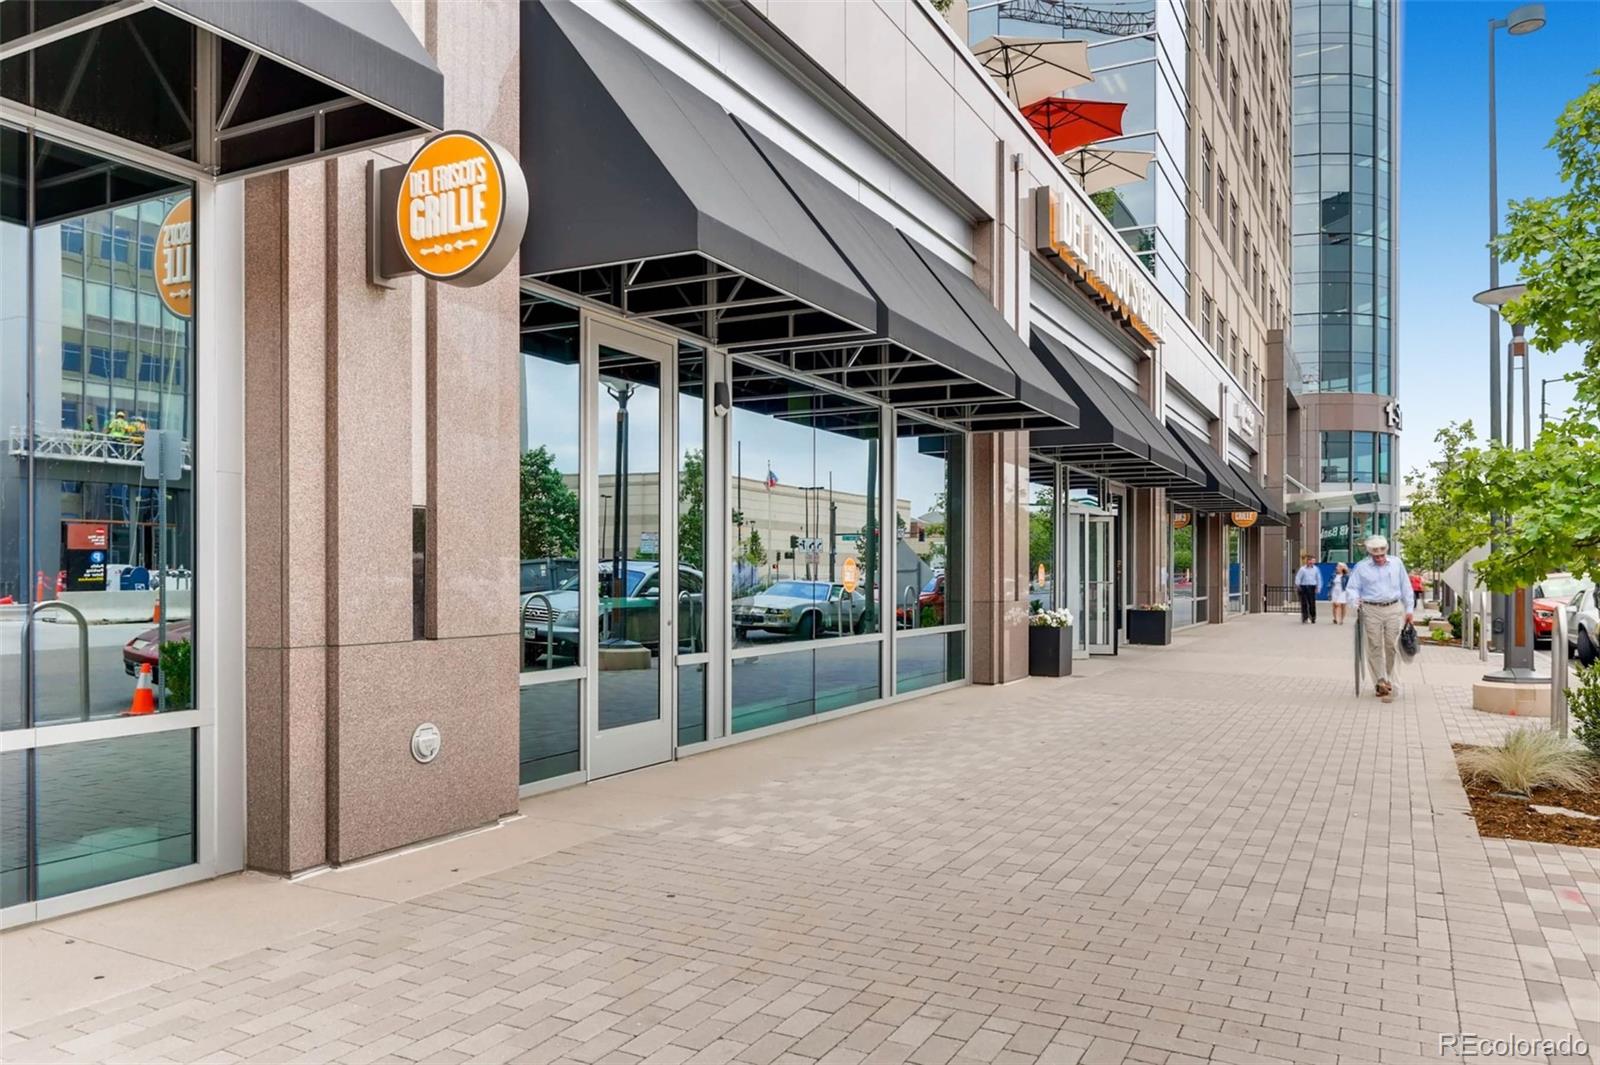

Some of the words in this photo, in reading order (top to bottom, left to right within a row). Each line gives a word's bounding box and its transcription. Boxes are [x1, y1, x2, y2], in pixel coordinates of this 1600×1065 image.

[410, 169, 431, 199] DEL
[432, 156, 487, 194] FRISCO'S
[410, 183, 488, 240] GRILLE
[1060, 192, 1088, 264] DEL
